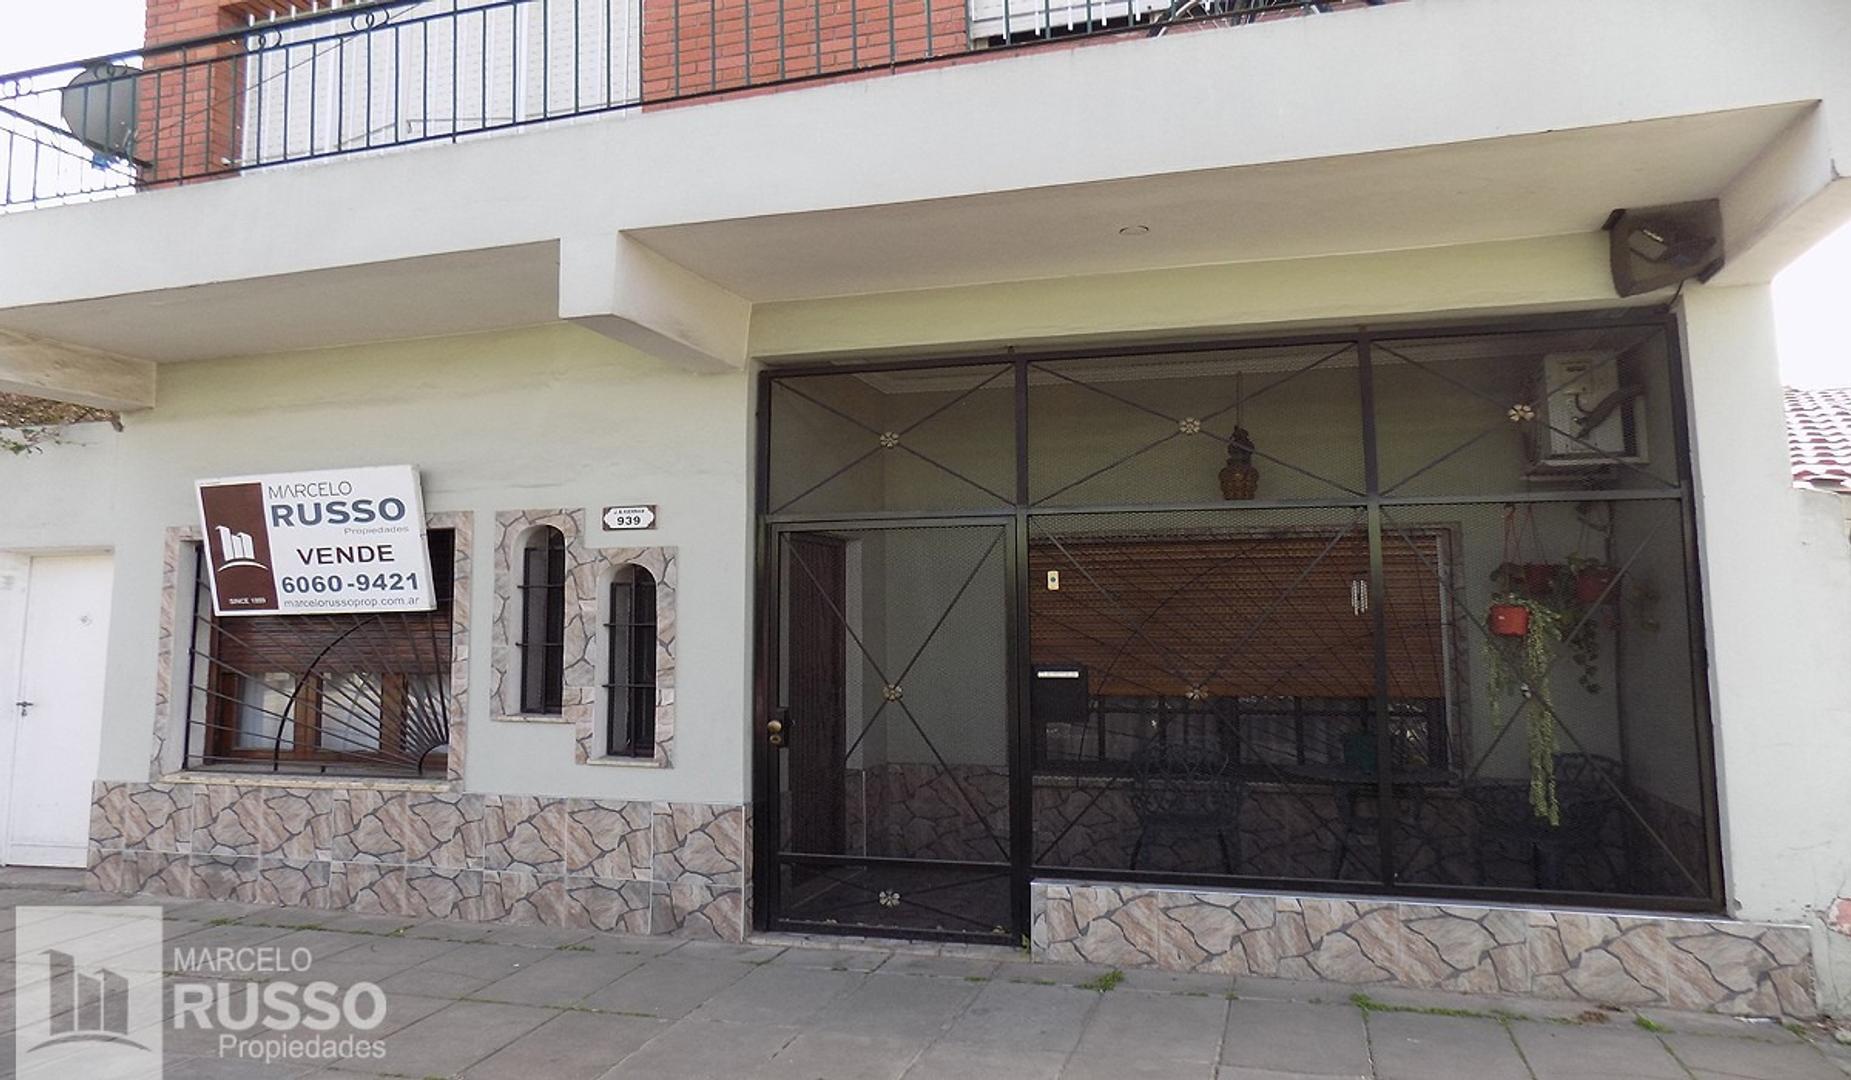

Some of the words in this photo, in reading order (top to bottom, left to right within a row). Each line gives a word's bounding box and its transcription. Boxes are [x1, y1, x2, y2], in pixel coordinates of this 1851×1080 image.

[268, 480, 352, 500] MARCELO
[271, 496, 406, 528] RUSSO
[617, 516, 641, 526] 939
[343, 525, 409, 536] Propiedades
[297, 544, 395, 566] VENDE
[281, 572, 418, 594] 6060-9421
[284, 596, 419, 609] marcelorussoprop.com.ar
